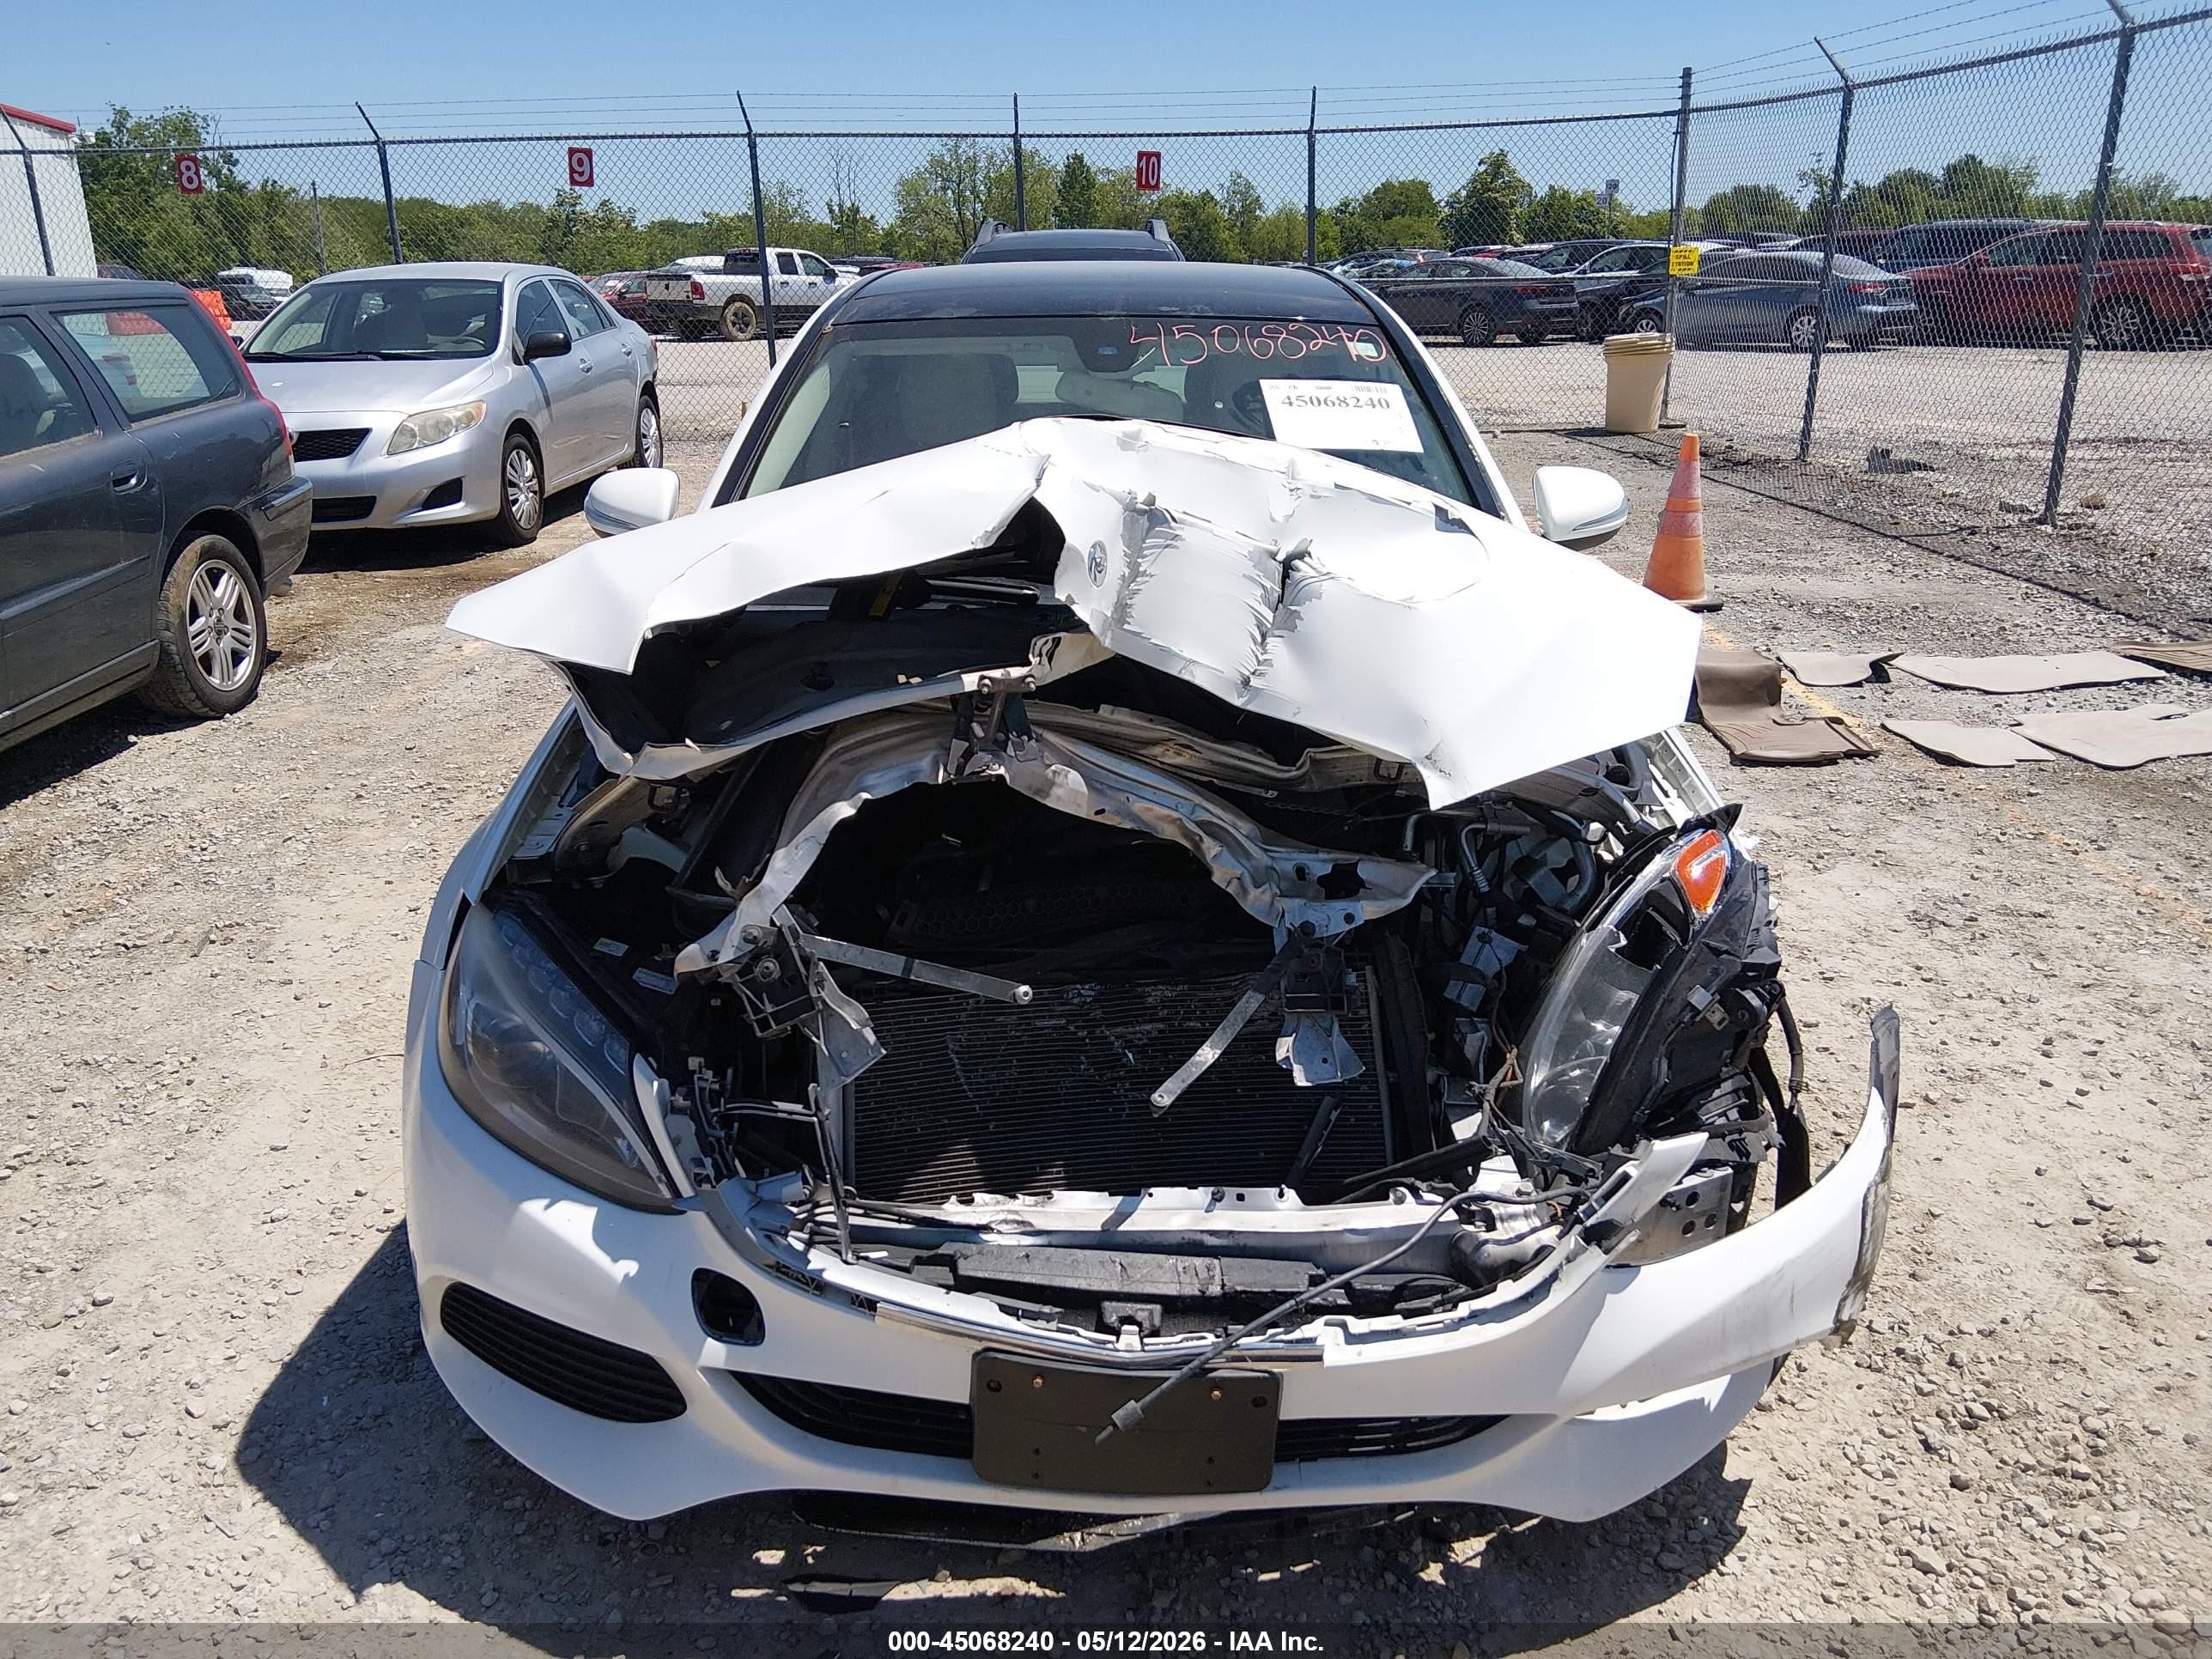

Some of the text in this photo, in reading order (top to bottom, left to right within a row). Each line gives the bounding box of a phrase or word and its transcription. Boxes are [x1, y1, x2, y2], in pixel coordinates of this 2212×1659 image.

[180, 160, 199, 190] 8
[571, 152, 591, 182] 9
[1139, 155, 1158, 186] 10
[1596, 197, 1607, 206] 20
[1128, 321, 1388, 368] 45068240
[1280, 394, 1390, 410] 45068240
